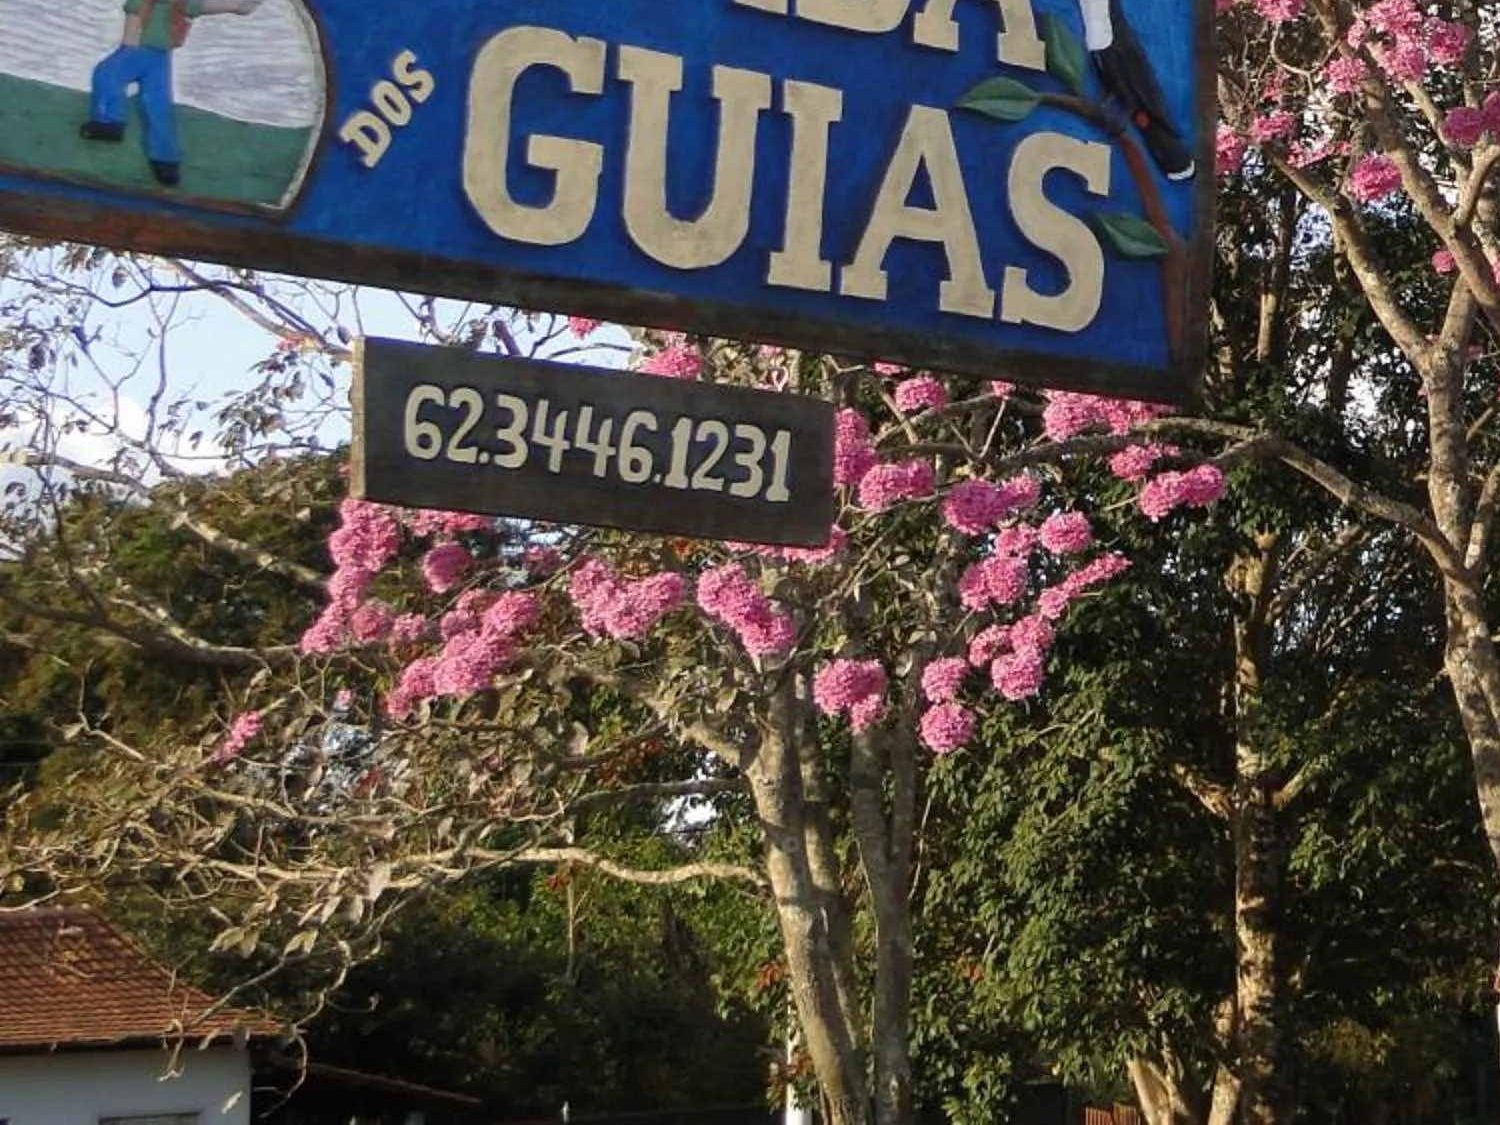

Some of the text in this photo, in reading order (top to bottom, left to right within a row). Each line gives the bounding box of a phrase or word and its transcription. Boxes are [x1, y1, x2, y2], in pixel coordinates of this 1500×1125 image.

[339, 25, 1111, 333] DOS GUIAS
[404, 384, 791, 503] 62.3446.1231
